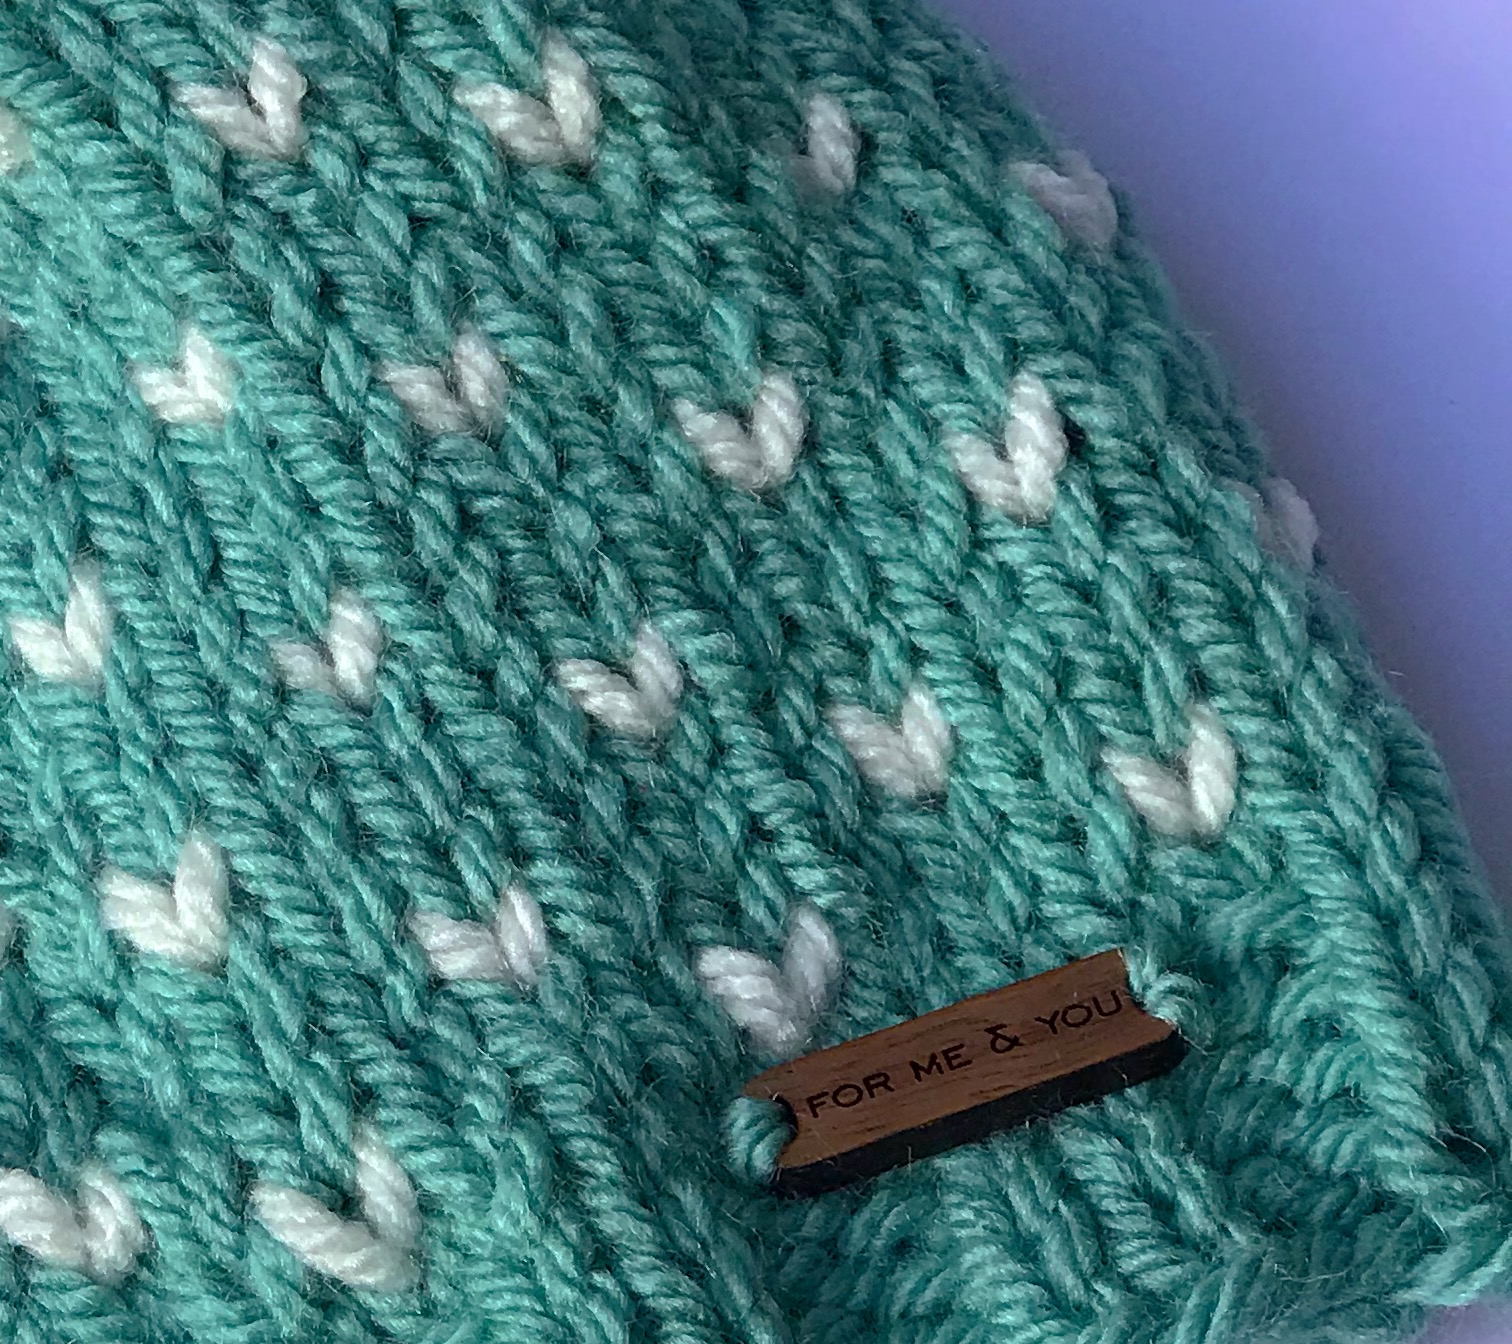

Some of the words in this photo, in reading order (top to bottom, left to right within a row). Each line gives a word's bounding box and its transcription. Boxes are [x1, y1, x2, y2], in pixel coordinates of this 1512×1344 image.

[805, 1071, 895, 1119] FOR
[909, 1043, 973, 1083] ME
[984, 1024, 1025, 1054] &
[1034, 990, 1123, 1035] YOU
